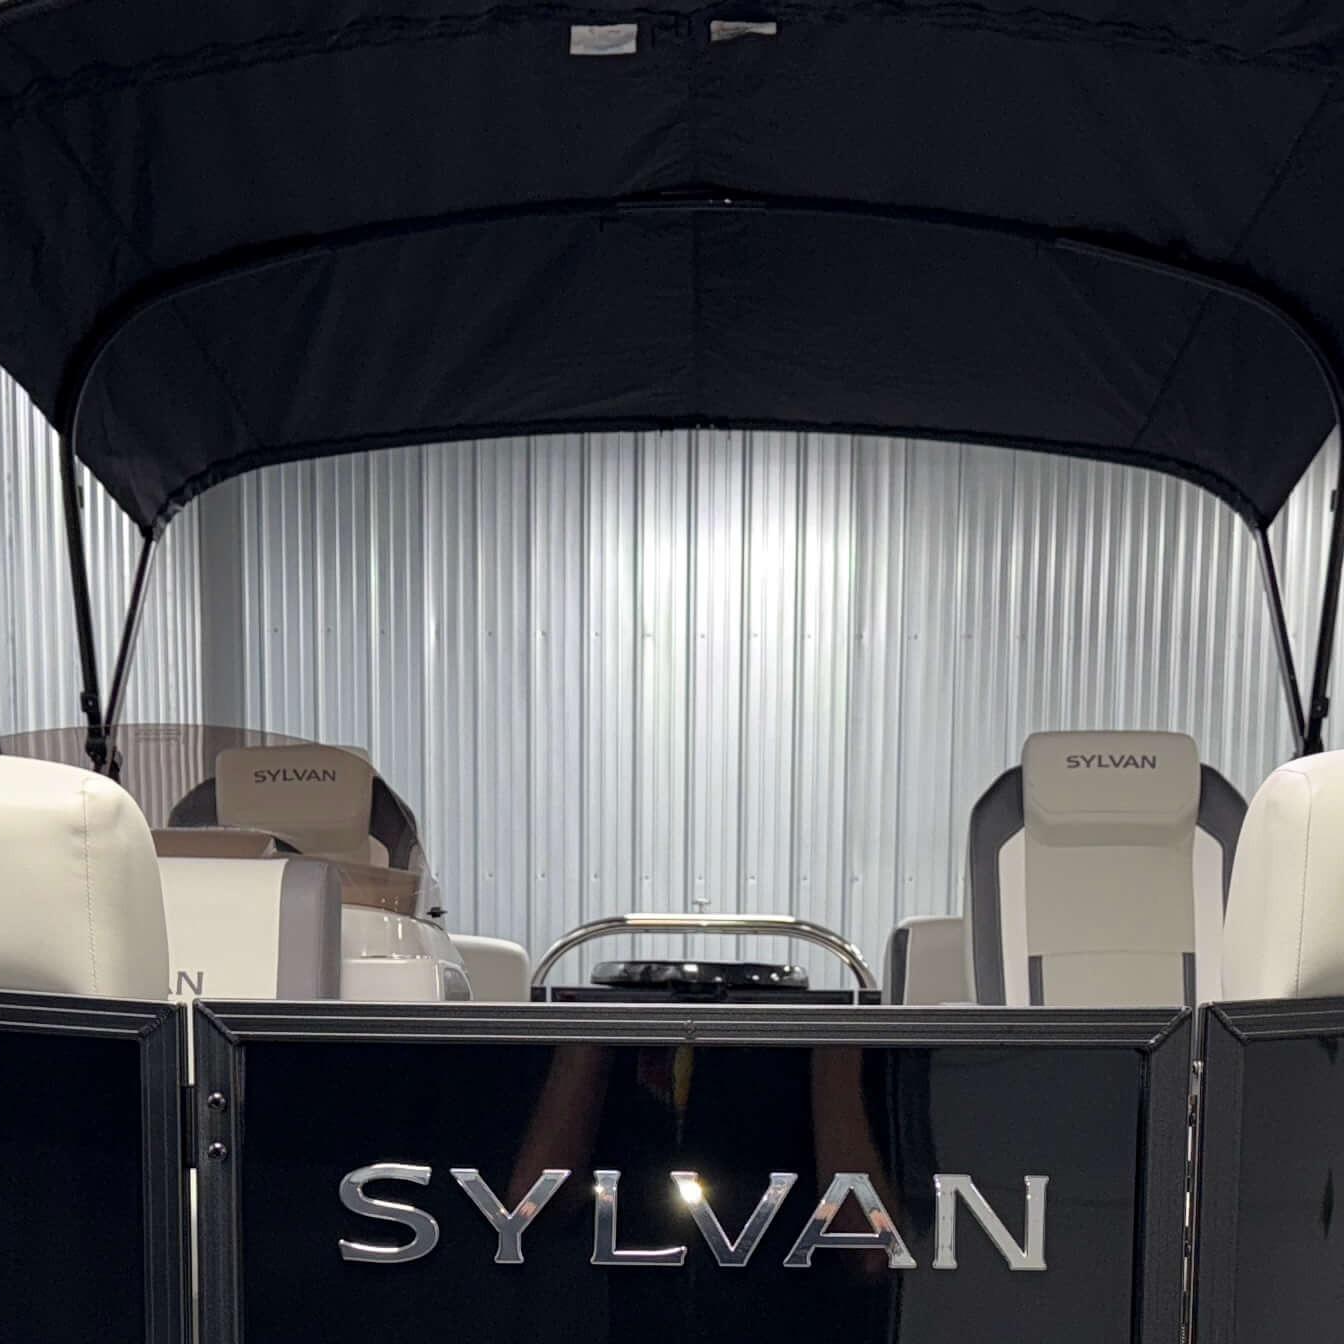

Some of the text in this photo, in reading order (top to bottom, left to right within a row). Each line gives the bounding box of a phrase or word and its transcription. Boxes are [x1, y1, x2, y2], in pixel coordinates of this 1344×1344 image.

[1066, 754, 1156, 769] SYLVAN
[253, 768, 336, 783] SYLVAN
[339, 1163, 1049, 1270] SYLVAN
